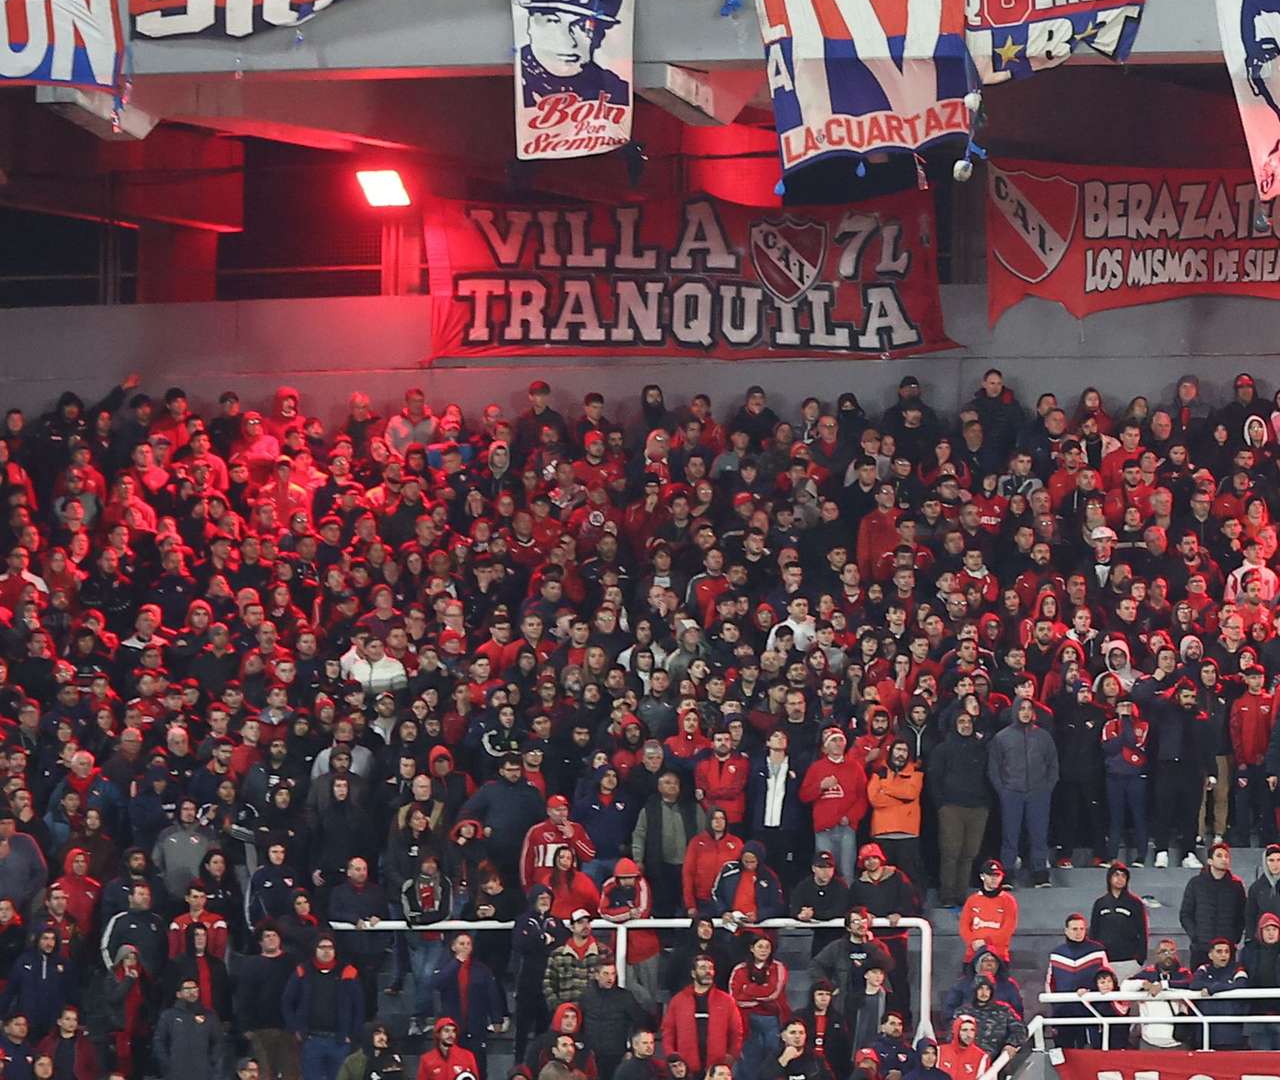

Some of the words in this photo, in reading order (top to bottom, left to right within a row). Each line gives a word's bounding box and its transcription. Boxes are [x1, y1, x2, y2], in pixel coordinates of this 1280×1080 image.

[466, 199, 742, 272] VILLA
[1084, 249, 1124, 293] LOS
[1126, 250, 1208, 288] MISMOS
[1212, 250, 1241, 284] DE
[455, 277, 922, 351] TRANQUILA
